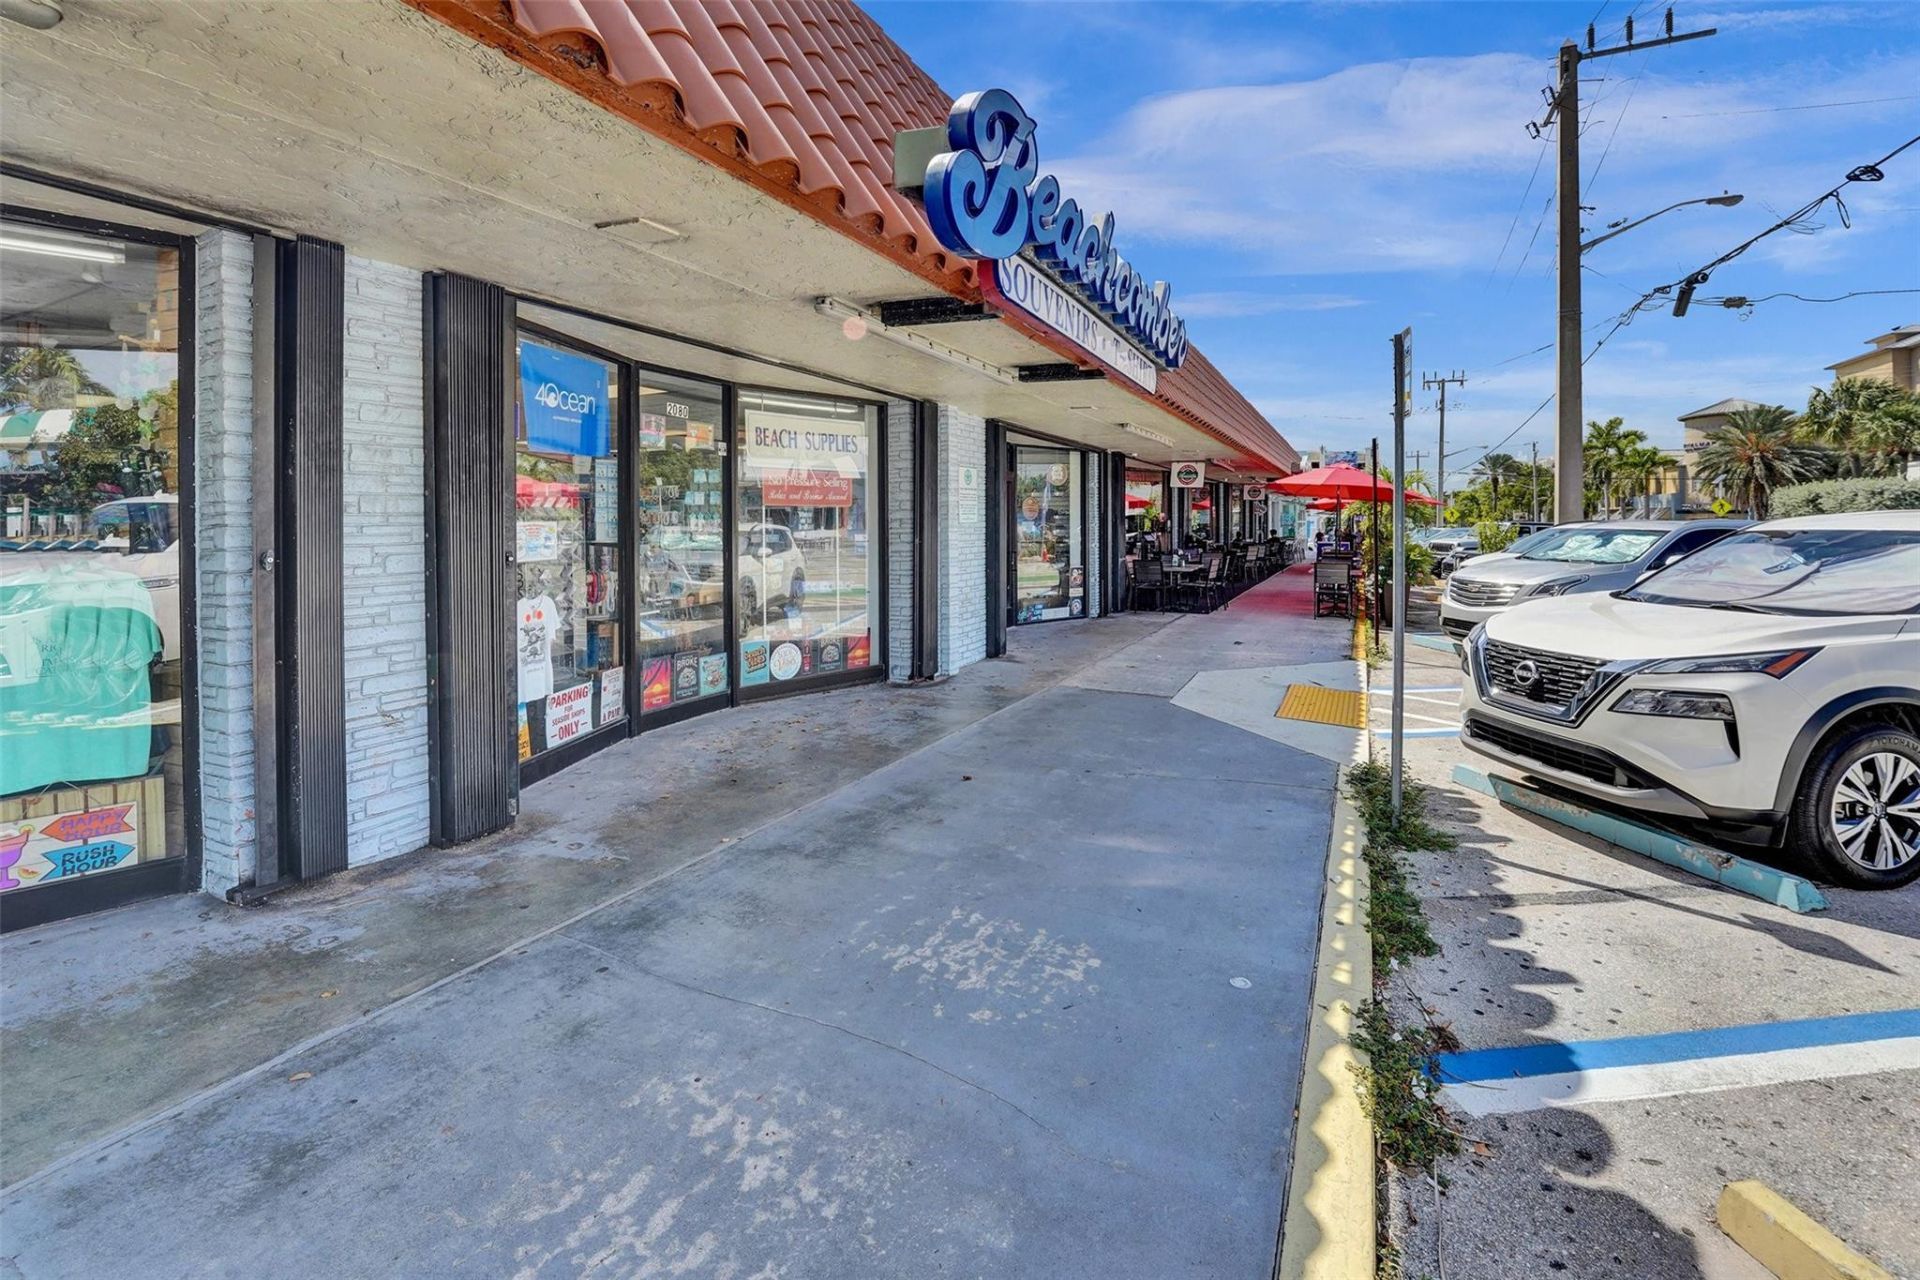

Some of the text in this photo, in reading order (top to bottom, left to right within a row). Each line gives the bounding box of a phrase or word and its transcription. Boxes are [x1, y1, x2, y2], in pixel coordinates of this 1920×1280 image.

[924, 88, 1188, 368] Beachcomber
[1001, 258, 1098, 351] SOUVENIRS
[667, 403, 688, 417] 2080
[755, 426, 858, 454] BEACH SUPPLIES
[784, 474, 821, 490] Pressure
[823, 473, 848, 491] Selling
[550, 685, 589, 709] PARKING
[558, 719, 580, 740] ONLY
[1873, 735, 1920, 753] YOKOHAM
[60, 811, 125, 830] HAPPY
[61, 844, 115, 867] RUSH
[61, 855, 118, 877] HOUR
